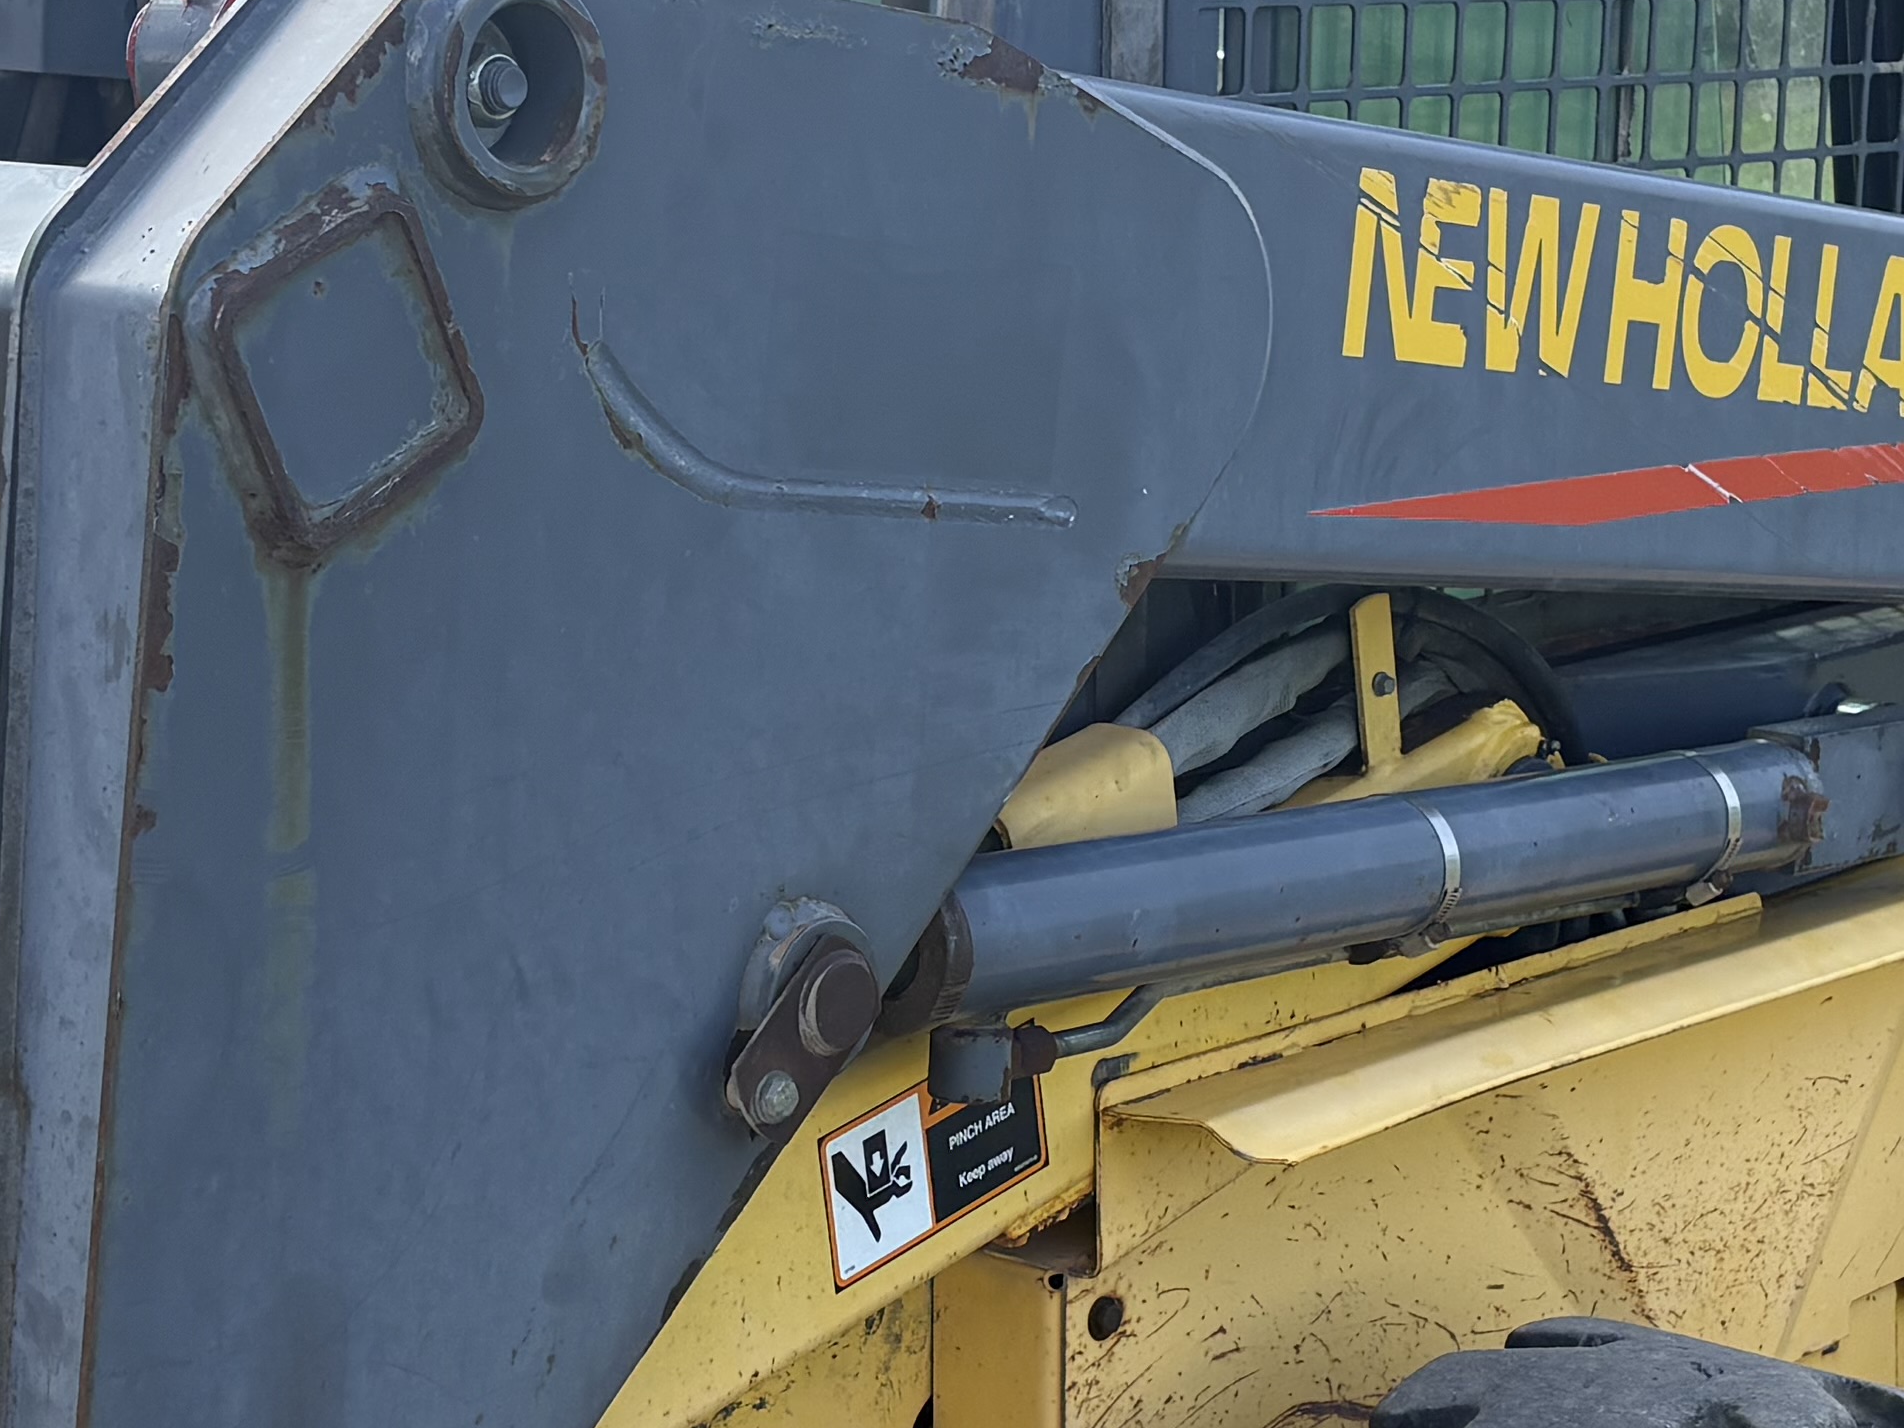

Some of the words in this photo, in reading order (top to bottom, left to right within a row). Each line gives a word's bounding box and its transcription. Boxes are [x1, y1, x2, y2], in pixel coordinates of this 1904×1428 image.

[1341, 167, 1600, 378] NEW
[948, 1120, 983, 1150] PINCH
[984, 1102, 1016, 1130] AREA
[958, 1167, 985, 1188] Keep
[987, 1146, 1015, 1172] away
